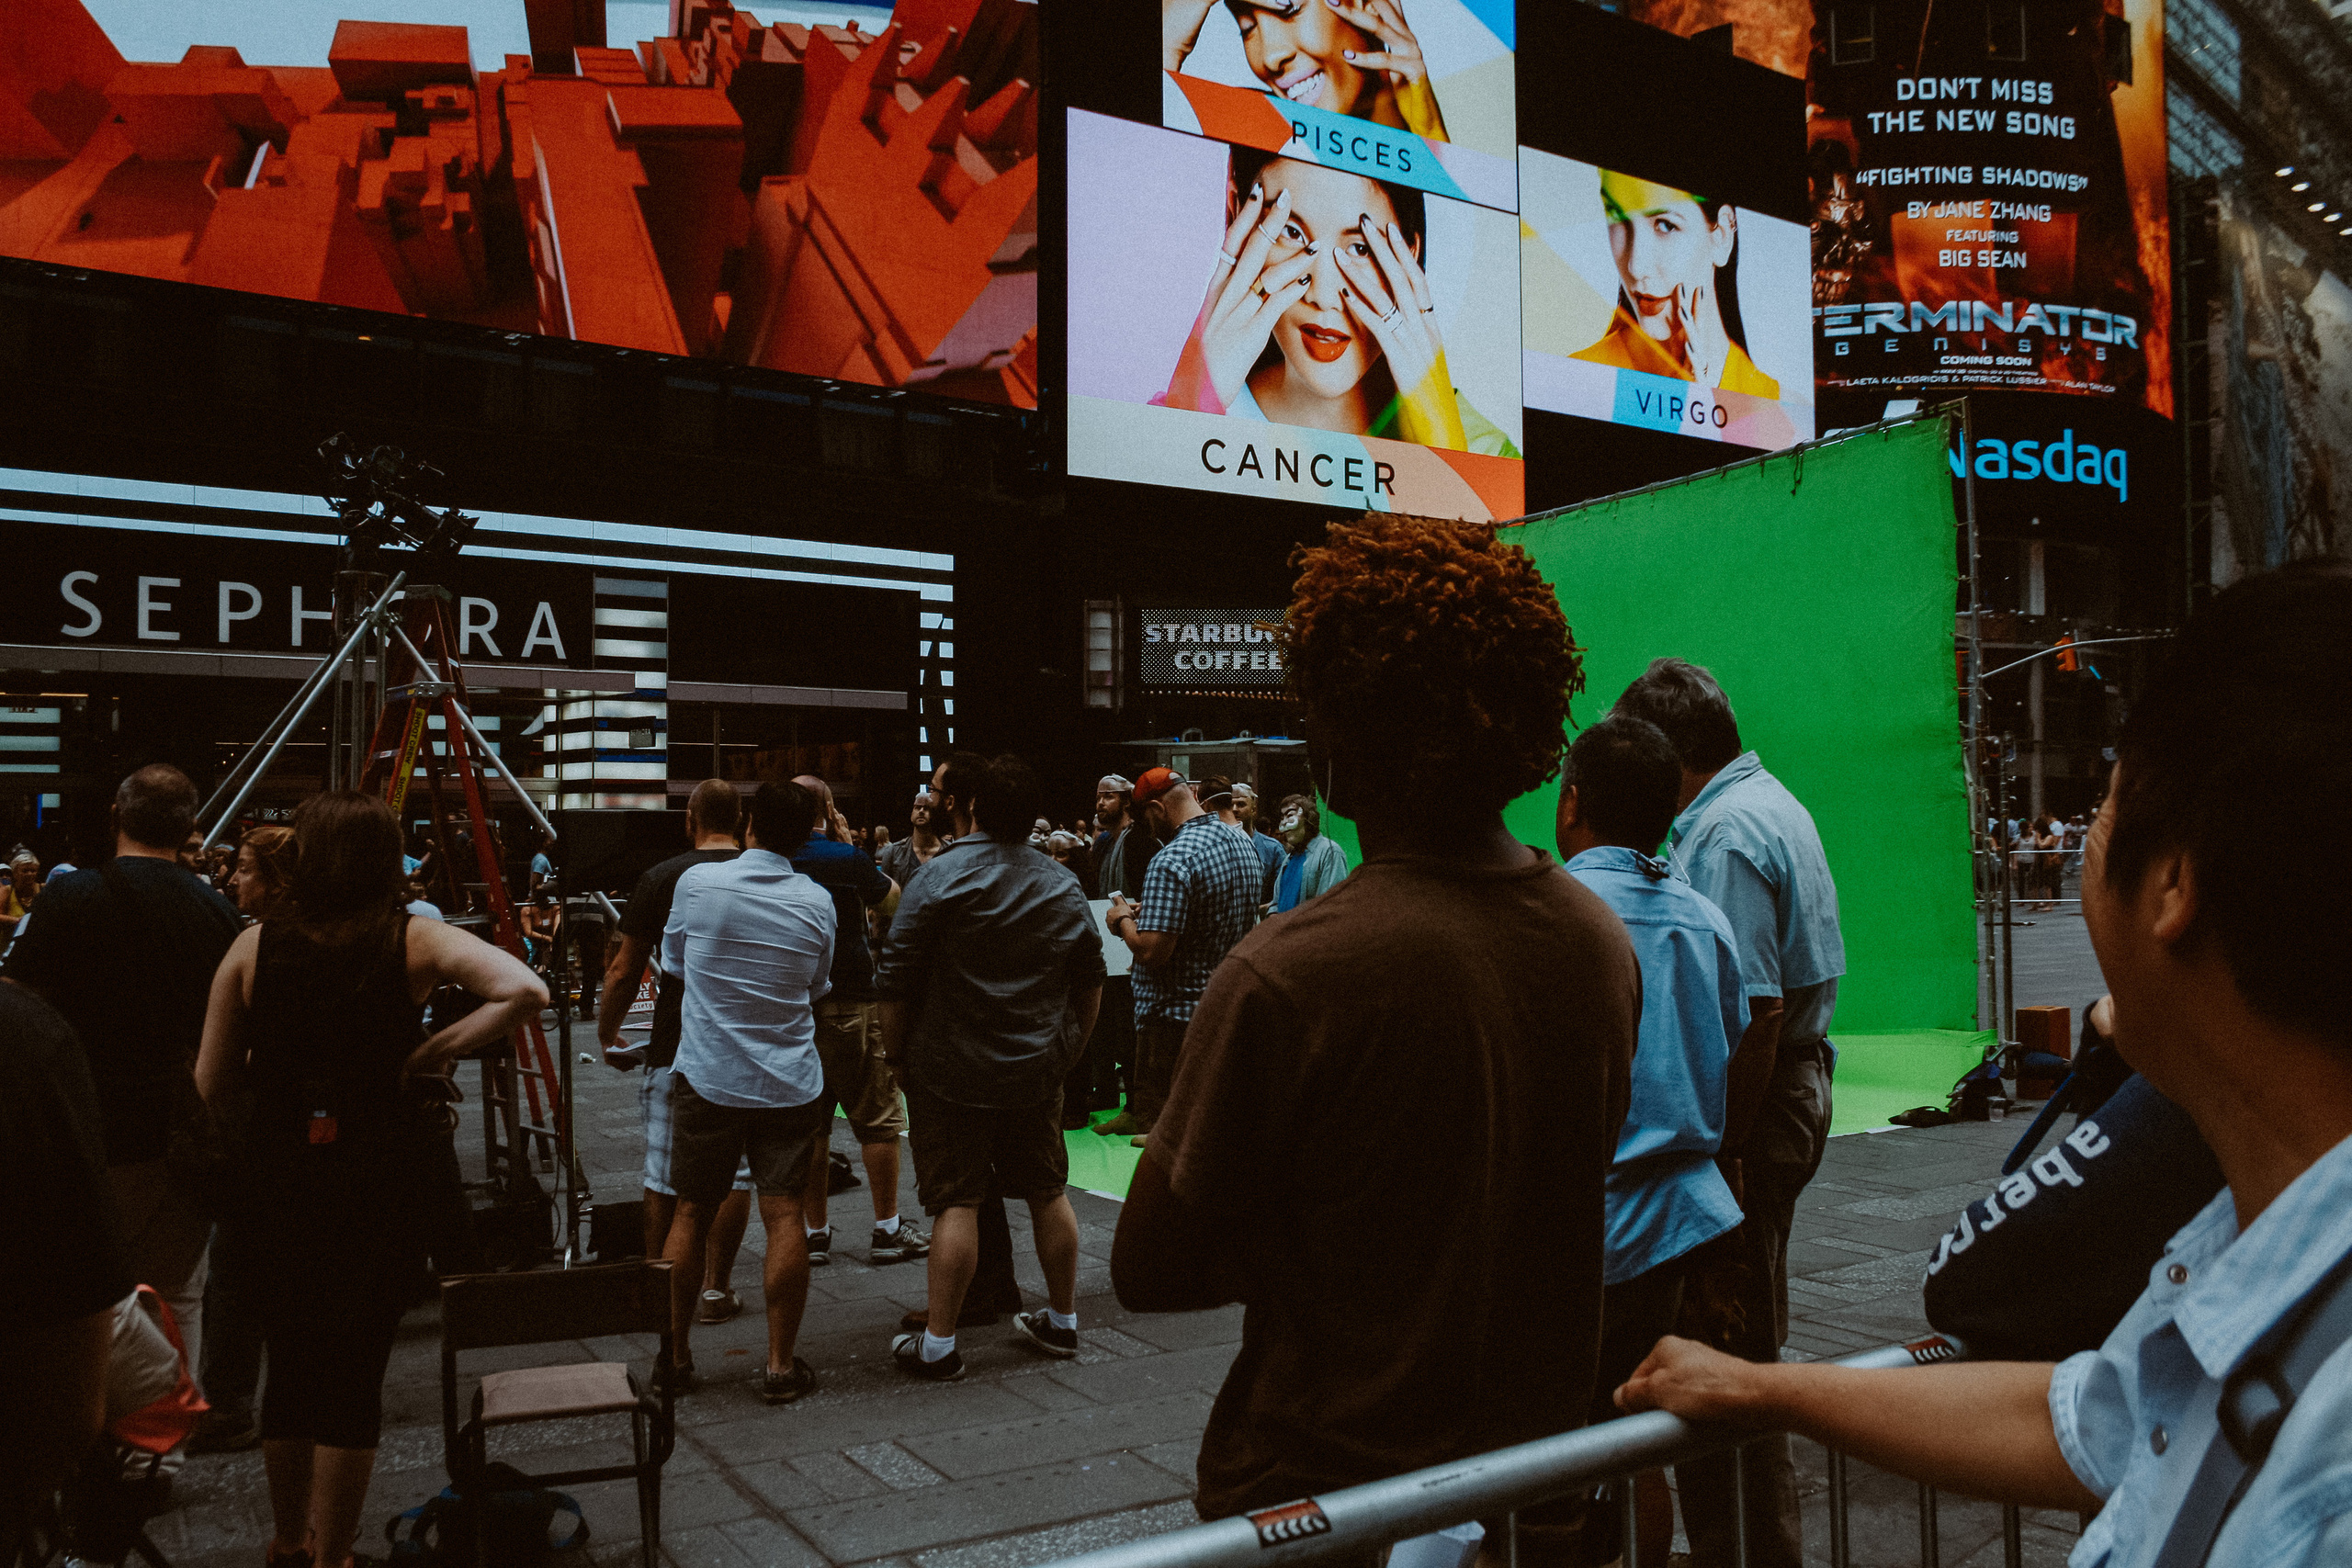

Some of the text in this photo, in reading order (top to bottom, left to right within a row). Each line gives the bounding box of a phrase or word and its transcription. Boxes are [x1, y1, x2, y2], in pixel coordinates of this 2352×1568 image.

[1896, 77, 2053, 105] DON'T MISS
[1867, 108, 2075, 140] THE NEW SONG
[1291, 119, 1414, 173] PISCES
[1855, 165, 2088, 192] "FIGHTING SHADOWS"
[1907, 200, 2052, 222] BY JANE ZHANG
[1946, 229, 2019, 243] FEATURING
[1939, 249, 2027, 268] BIG SEAN
[1812, 299, 2139, 350] ERMINATOR
[1834, 336, 2107, 362] GENISYS
[1939, 355, 2032, 367] COMING SOON
[1962, 375, 2004, 384] PATRICK
[1634, 388, 1728, 429] VIRGO
[1199, 438, 1397, 496] CANCER
[60, 570, 567, 660] SEPHRA
[1145, 623, 1292, 643] STARBU
[1174, 650, 1284, 671] COFFEE
[411, 711, 423, 739] SHOOT
